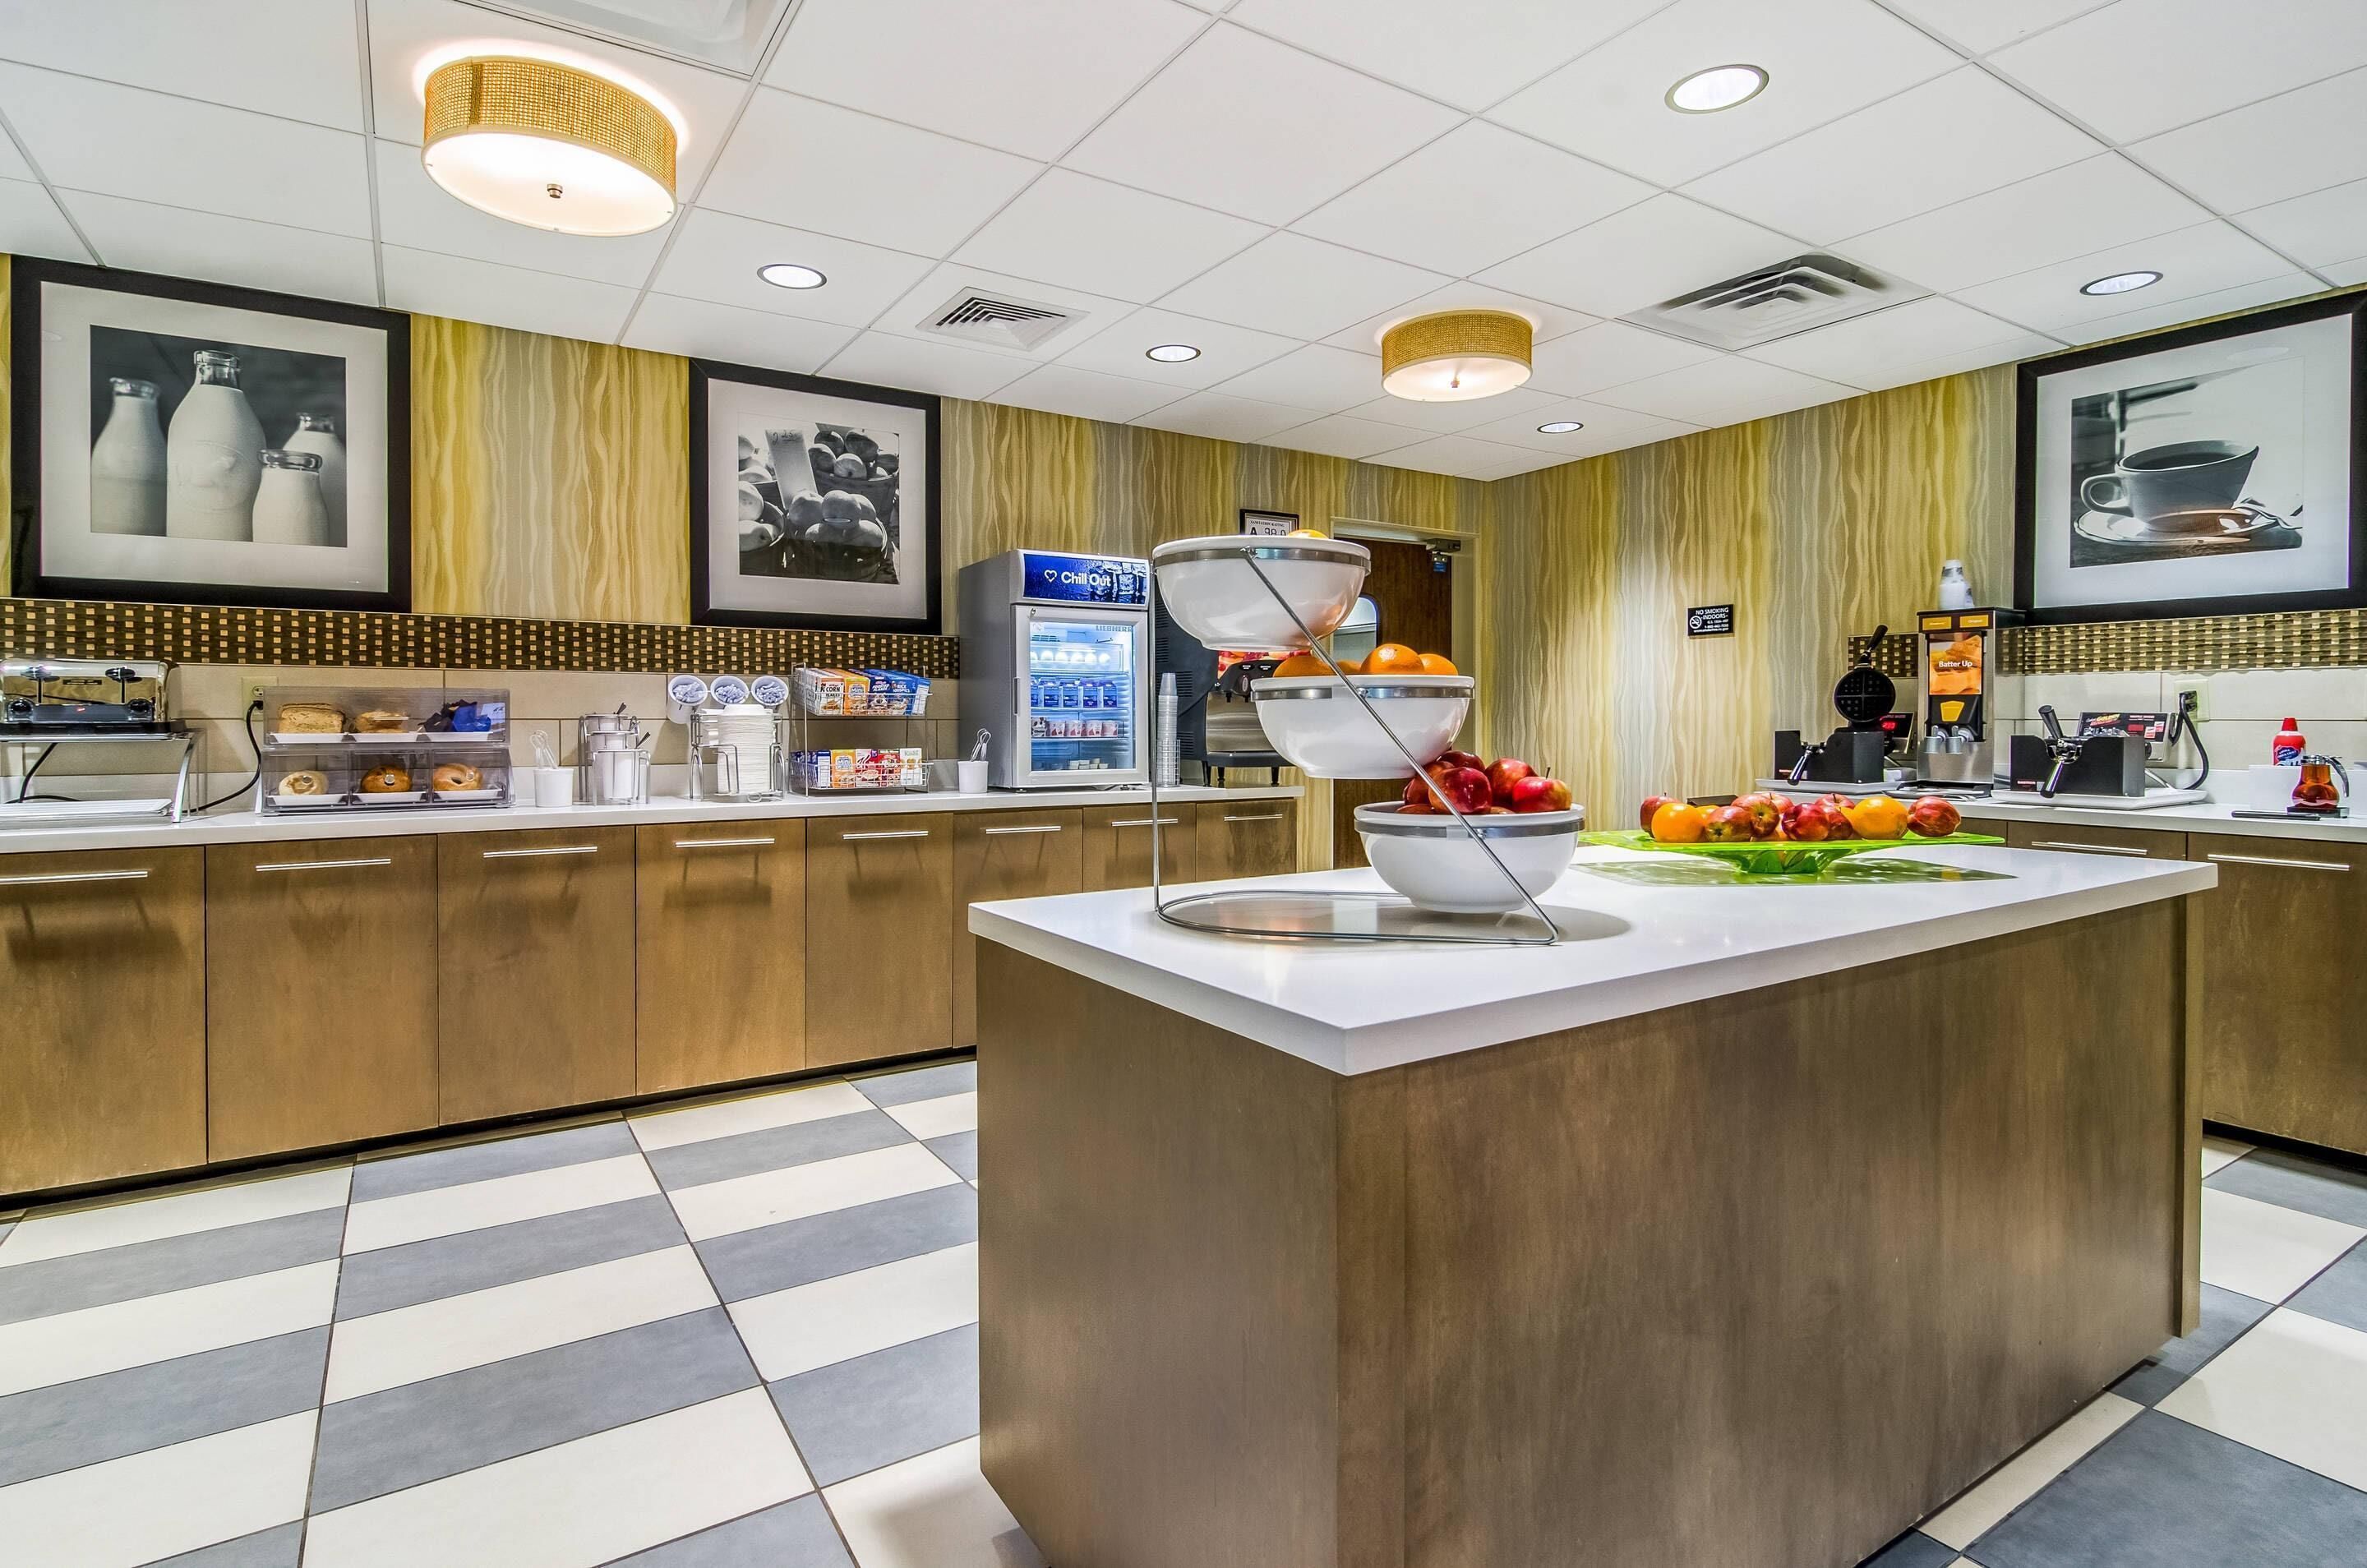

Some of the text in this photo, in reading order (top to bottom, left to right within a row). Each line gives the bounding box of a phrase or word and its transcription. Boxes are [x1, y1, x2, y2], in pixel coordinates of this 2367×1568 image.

[1250, 527, 1257, 536] A
[1061, 571, 1111, 587] Chill Out
